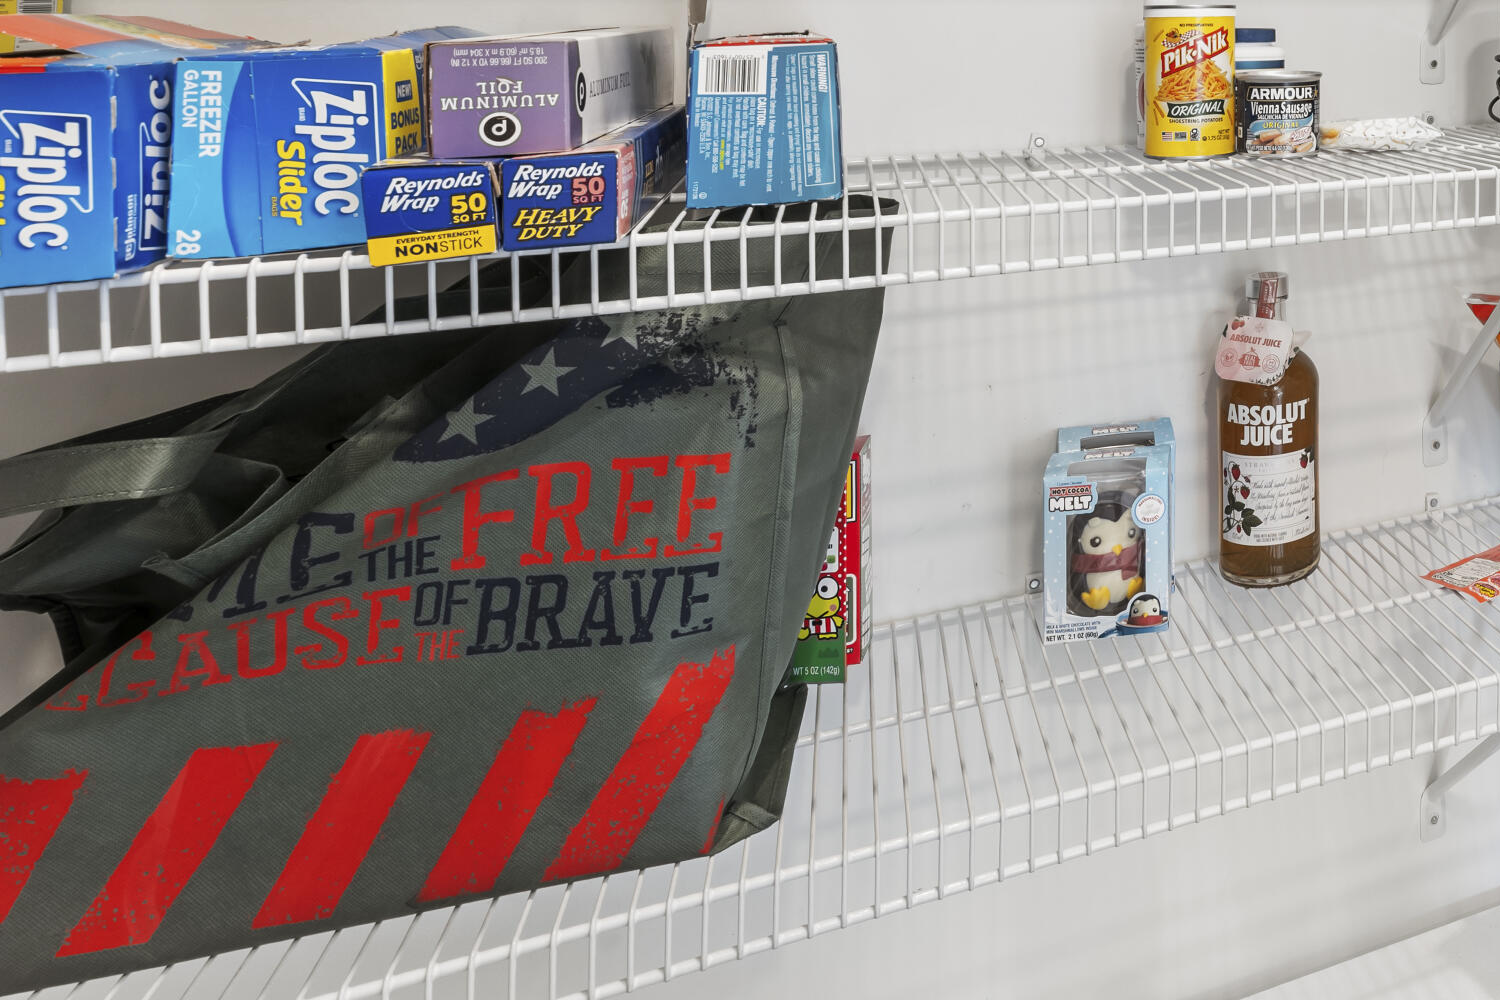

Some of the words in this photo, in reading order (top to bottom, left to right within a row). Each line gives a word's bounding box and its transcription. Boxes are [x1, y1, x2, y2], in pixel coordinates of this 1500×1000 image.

[536, 56, 548, 65] 200
[817, 54, 828, 93] WARNING!
[397, 82, 412, 100] NEW!
[476, 78, 523, 95] FOIL
[589, 74, 618, 98] ALUMINUM
[1250, 87, 1313, 100] ARMOUR
[182, 69, 200, 128] GALLON
[440, 94, 559, 111] ALUMINUM
[1171, 102, 1222, 116] ORIGINAL
[198, 69, 222, 158] FREEZER
[391, 107, 420, 129] BONUS
[1250, 102, 1280, 116] Vienna
[1280, 102, 1312, 117] Sausage
[294, 89, 369, 217] Ziploc
[395, 137, 418, 155] PACK
[144, 79, 172, 240] Ziploc
[276, 139, 308, 226] Slider
[513, 162, 605, 182] Reynolds
[0, 121, 83, 250] Ziploc
[386, 171, 484, 196] Reynolds
[508, 181, 562, 200] Wrap
[571, 176, 605, 196] 50
[380, 194, 440, 214] Wrap
[451, 193, 487, 214] 50
[573, 195, 589, 204] SQ
[591, 193, 604, 203] FT
[453, 213, 470, 223] SQ
[472, 212, 487, 221] FT
[513, 206, 602, 227] HEAVY
[175, 229, 201, 256] 28
[396, 235, 436, 245] EVERYDAY
[437, 229, 479, 241] STRENGTH
[518, 223, 583, 241] DUTY
[395, 236, 483, 258] NONSTICK
[1230, 333, 1263, 346] ABSOLUT
[1262, 336, 1282, 348] JUICE
[1227, 398, 1309, 426] ABSOLUT
[1240, 423, 1293, 447] JUICE
[450, 452, 732, 572] FREE
[1049, 495, 1092, 512] MELT
[363, 492, 443, 550] OF
[358, 536, 441, 582] THE
[414, 580, 473, 627] OF
[466, 562, 721, 658] BRAVE
[414, 628, 466, 663] THE
[804, 666, 809, 675] 5
[810, 666, 819, 675] OZ
[820, 665, 840, 676] (142g)
